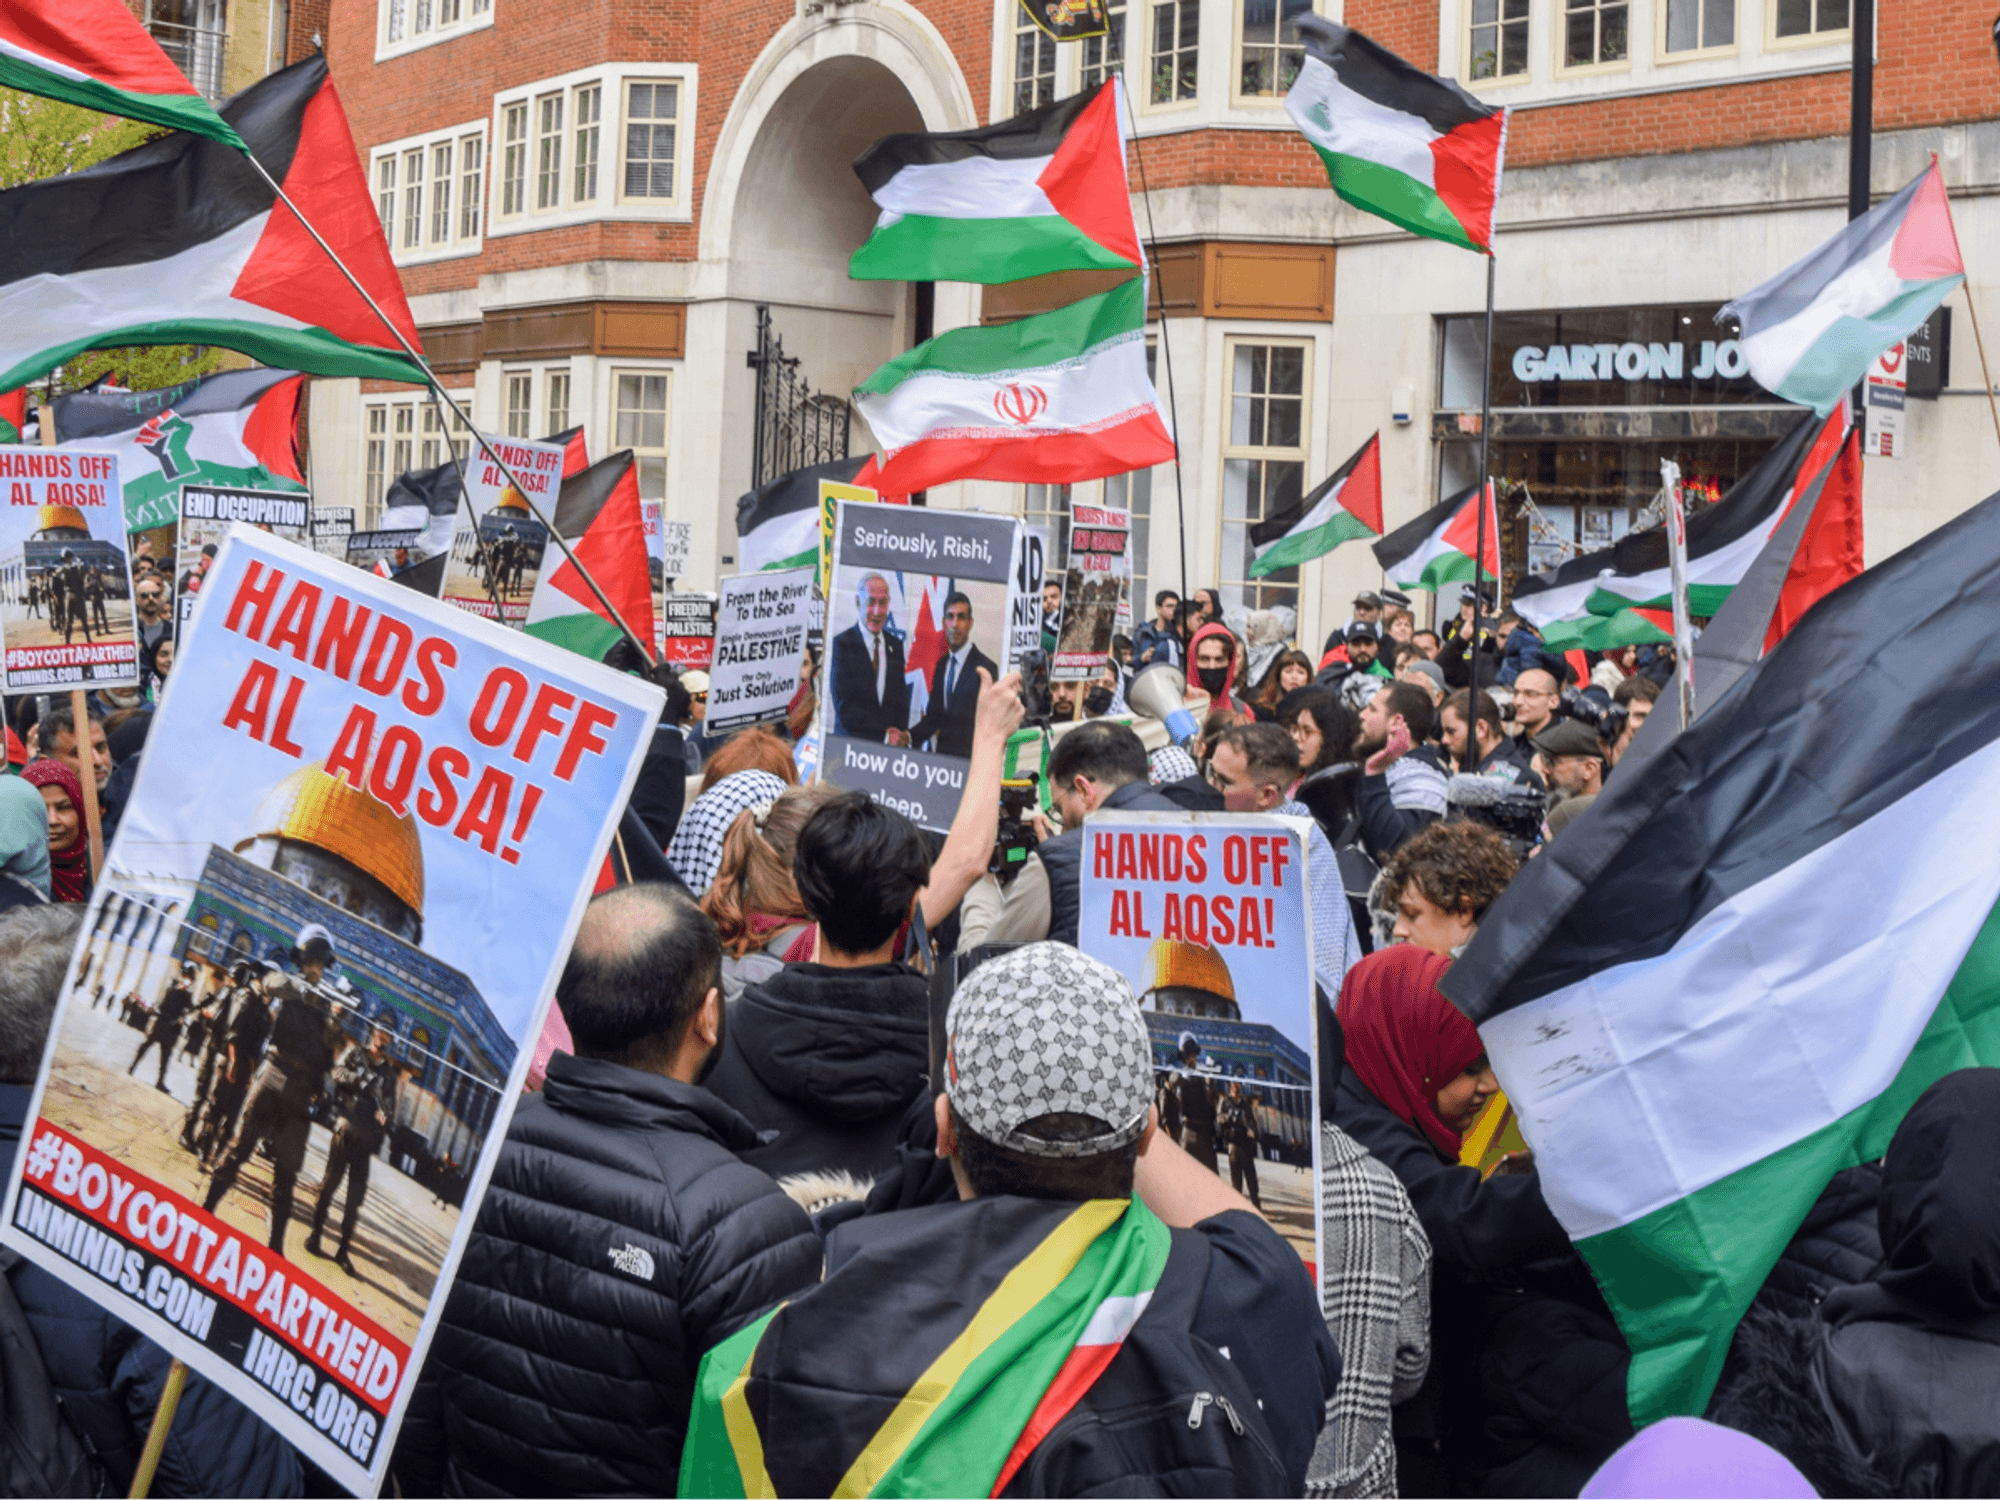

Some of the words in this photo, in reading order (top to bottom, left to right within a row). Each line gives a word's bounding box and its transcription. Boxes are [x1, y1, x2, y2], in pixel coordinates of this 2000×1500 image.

[1512, 341, 1684, 383] GARTON
[1691, 339, 1751, 379] JO
[1907, 344, 1932, 364] ENTS
[0, 454, 72, 479] HANDS
[78, 456, 112, 480] OFF
[481, 465, 502, 488] AL
[535, 451, 559, 472] OFF
[10, 482, 39, 507] AL
[46, 482, 107, 508] AQSA!
[185, 491, 216, 518] END
[216, 494, 306, 525] OCCUPATION
[853, 525, 938, 560] Seriously,
[942, 534, 993, 565] Rishi,
[1017, 535, 1043, 594] ND
[668, 601, 712, 617] FREEDOM
[725, 593, 756, 608] From
[758, 586, 779, 603] the
[781, 583, 808, 601] River
[737, 606, 749, 621] To
[753, 604, 773, 620] the
[776, 602, 796, 617] Sea
[1013, 596, 1041, 627] NIST
[666, 621, 714, 637] PALESTINE
[7, 644, 136, 668] #BOYCOTTAPARTHEID
[717, 634, 801, 666] PALESTINE
[223, 558, 459, 718] HANDS
[468, 665, 619, 783] OFF
[713, 685, 741, 705] Just
[745, 677, 795, 699] Solution
[222, 656, 306, 761] AL
[323, 706, 546, 868] AQSA!
[844, 744, 889, 774] how
[891, 753, 920, 780] do
[924, 764, 964, 790] you
[1093, 831, 1208, 884] HANDS
[1222, 834, 1290, 888] OFF
[1108, 889, 1152, 939] AL
[1163, 892, 1276, 949] AQSA!
[25, 1129, 400, 1402] #BOYCOTTAPARTHEID
[14, 1187, 218, 1342] INMINDS.COM
[242, 1328, 377, 1463] IHRC.ORG
